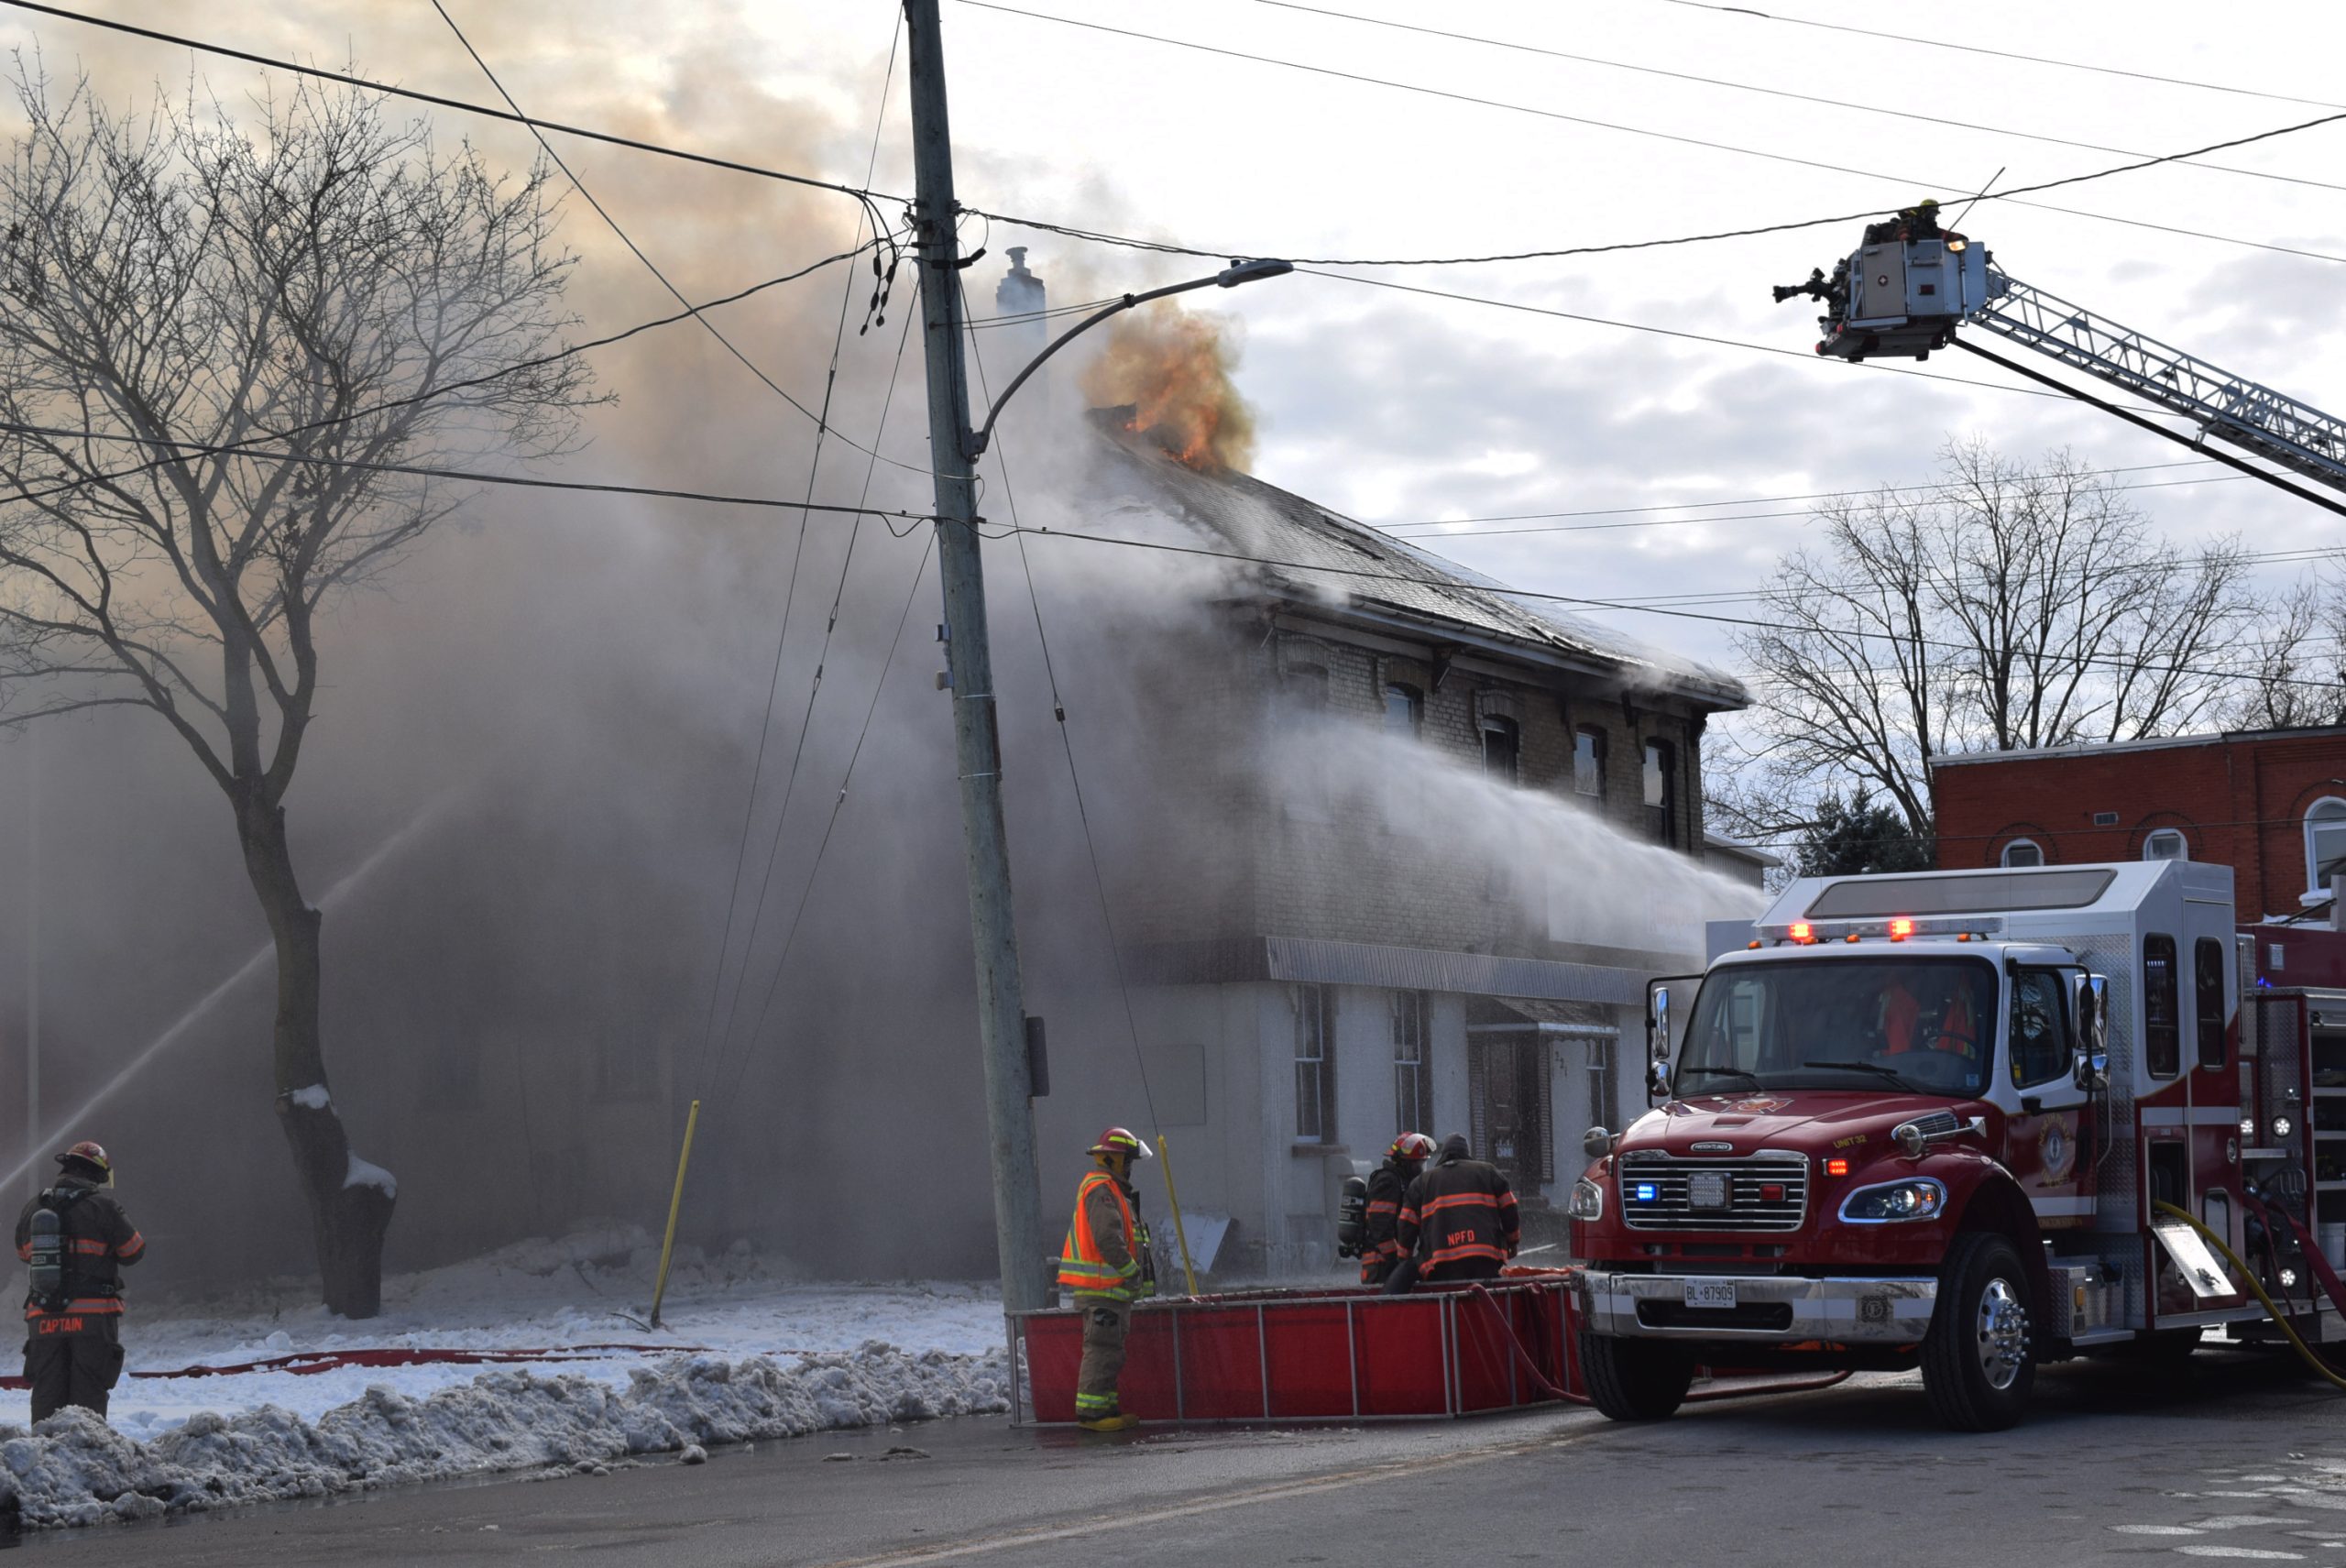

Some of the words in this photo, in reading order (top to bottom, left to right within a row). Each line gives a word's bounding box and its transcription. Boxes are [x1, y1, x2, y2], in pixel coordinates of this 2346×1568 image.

[1833, 1136, 1855, 1148] UNIT
[1854, 1135, 1868, 1144] 32
[1447, 1230, 1475, 1246] NPFD
[1687, 1286, 1698, 1300] BL
[1704, 1287, 1733, 1300] 87909
[38, 1317, 83, 1335] CAPTAIN
